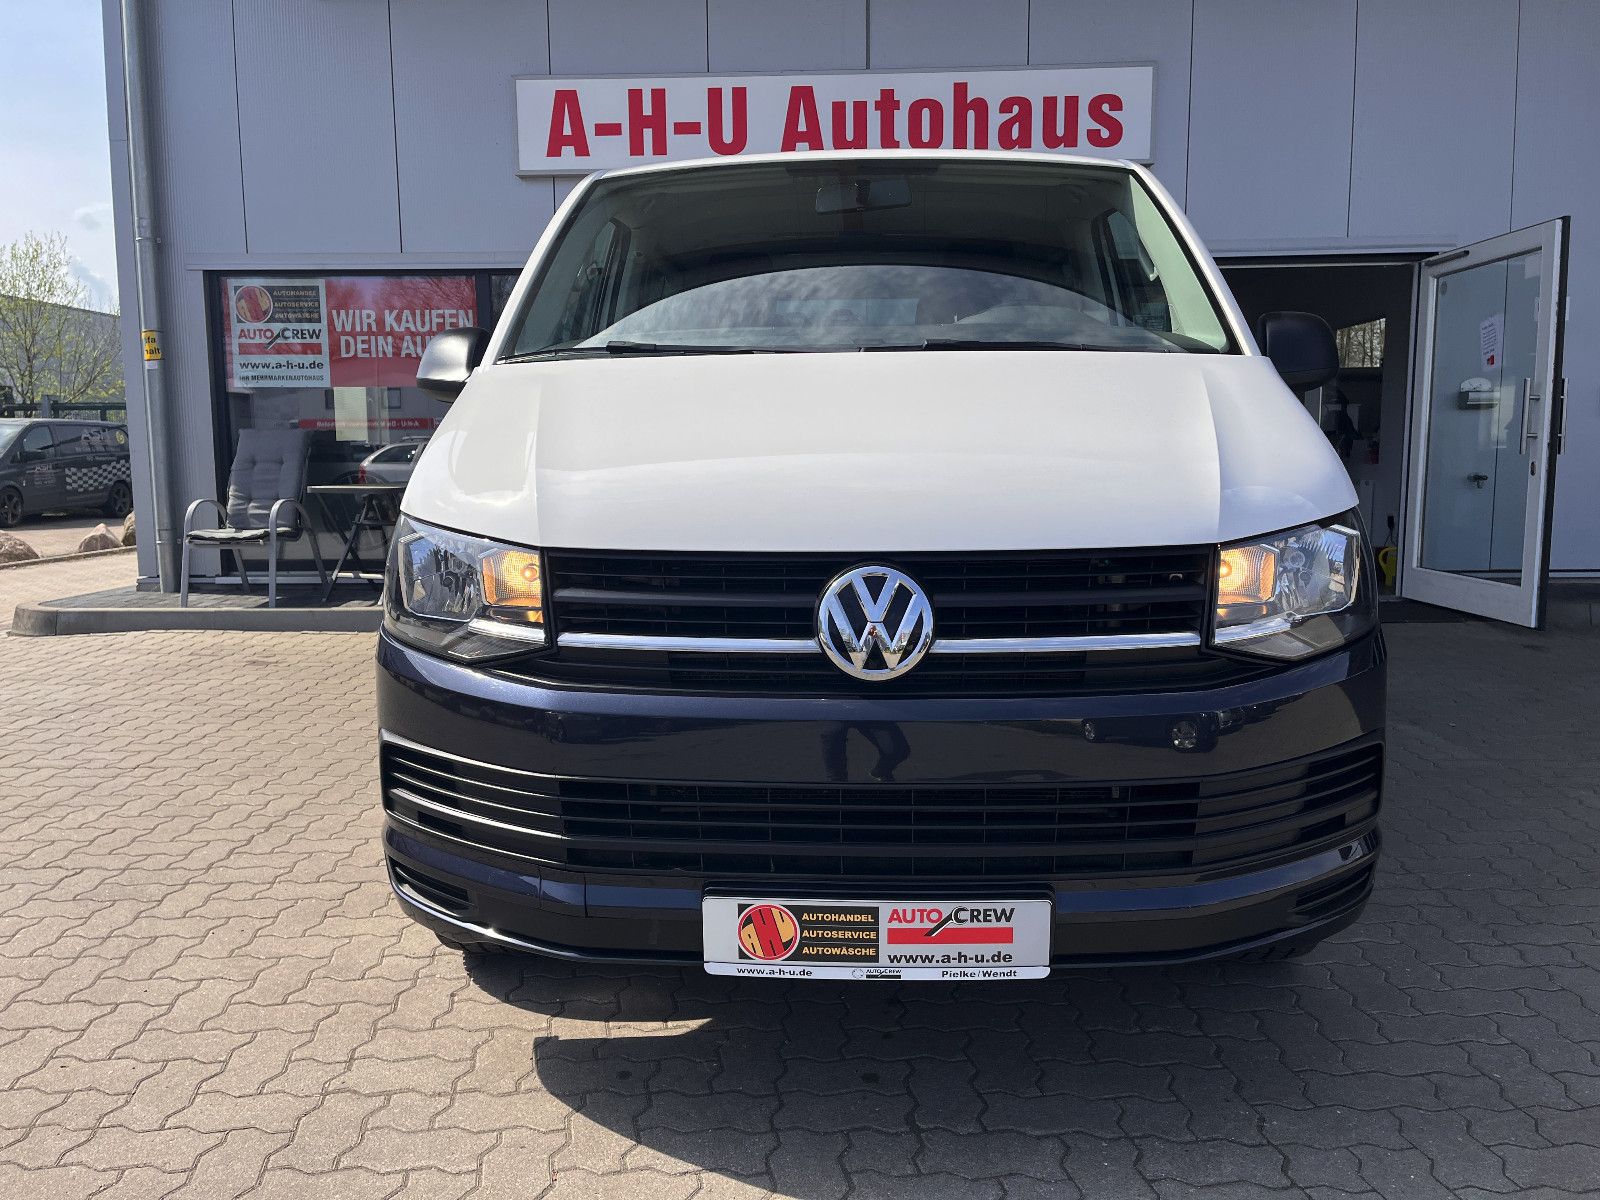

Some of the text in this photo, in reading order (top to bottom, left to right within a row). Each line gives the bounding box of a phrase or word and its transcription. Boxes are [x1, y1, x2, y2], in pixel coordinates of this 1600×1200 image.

[546, 81, 1124, 157] A-H-U Autohaus
[332, 309, 474, 332] WIR KAUFEN
[238, 327, 322, 340] AUTO CREW
[340, 335, 432, 358] DEIN AU
[239, 360, 324, 370] www.a-h-u.de
[801, 912, 875, 923] AUTOHANDEL
[887, 906, 1016, 925] AUTO CREW
[801, 929, 877, 939] AUTOSERVICE
[802, 945, 877, 956] AUTOWÄSCHE
[887, 950, 1013, 964] www.a-h-u.de
[736, 967, 813, 977] www.a-h-u.de
